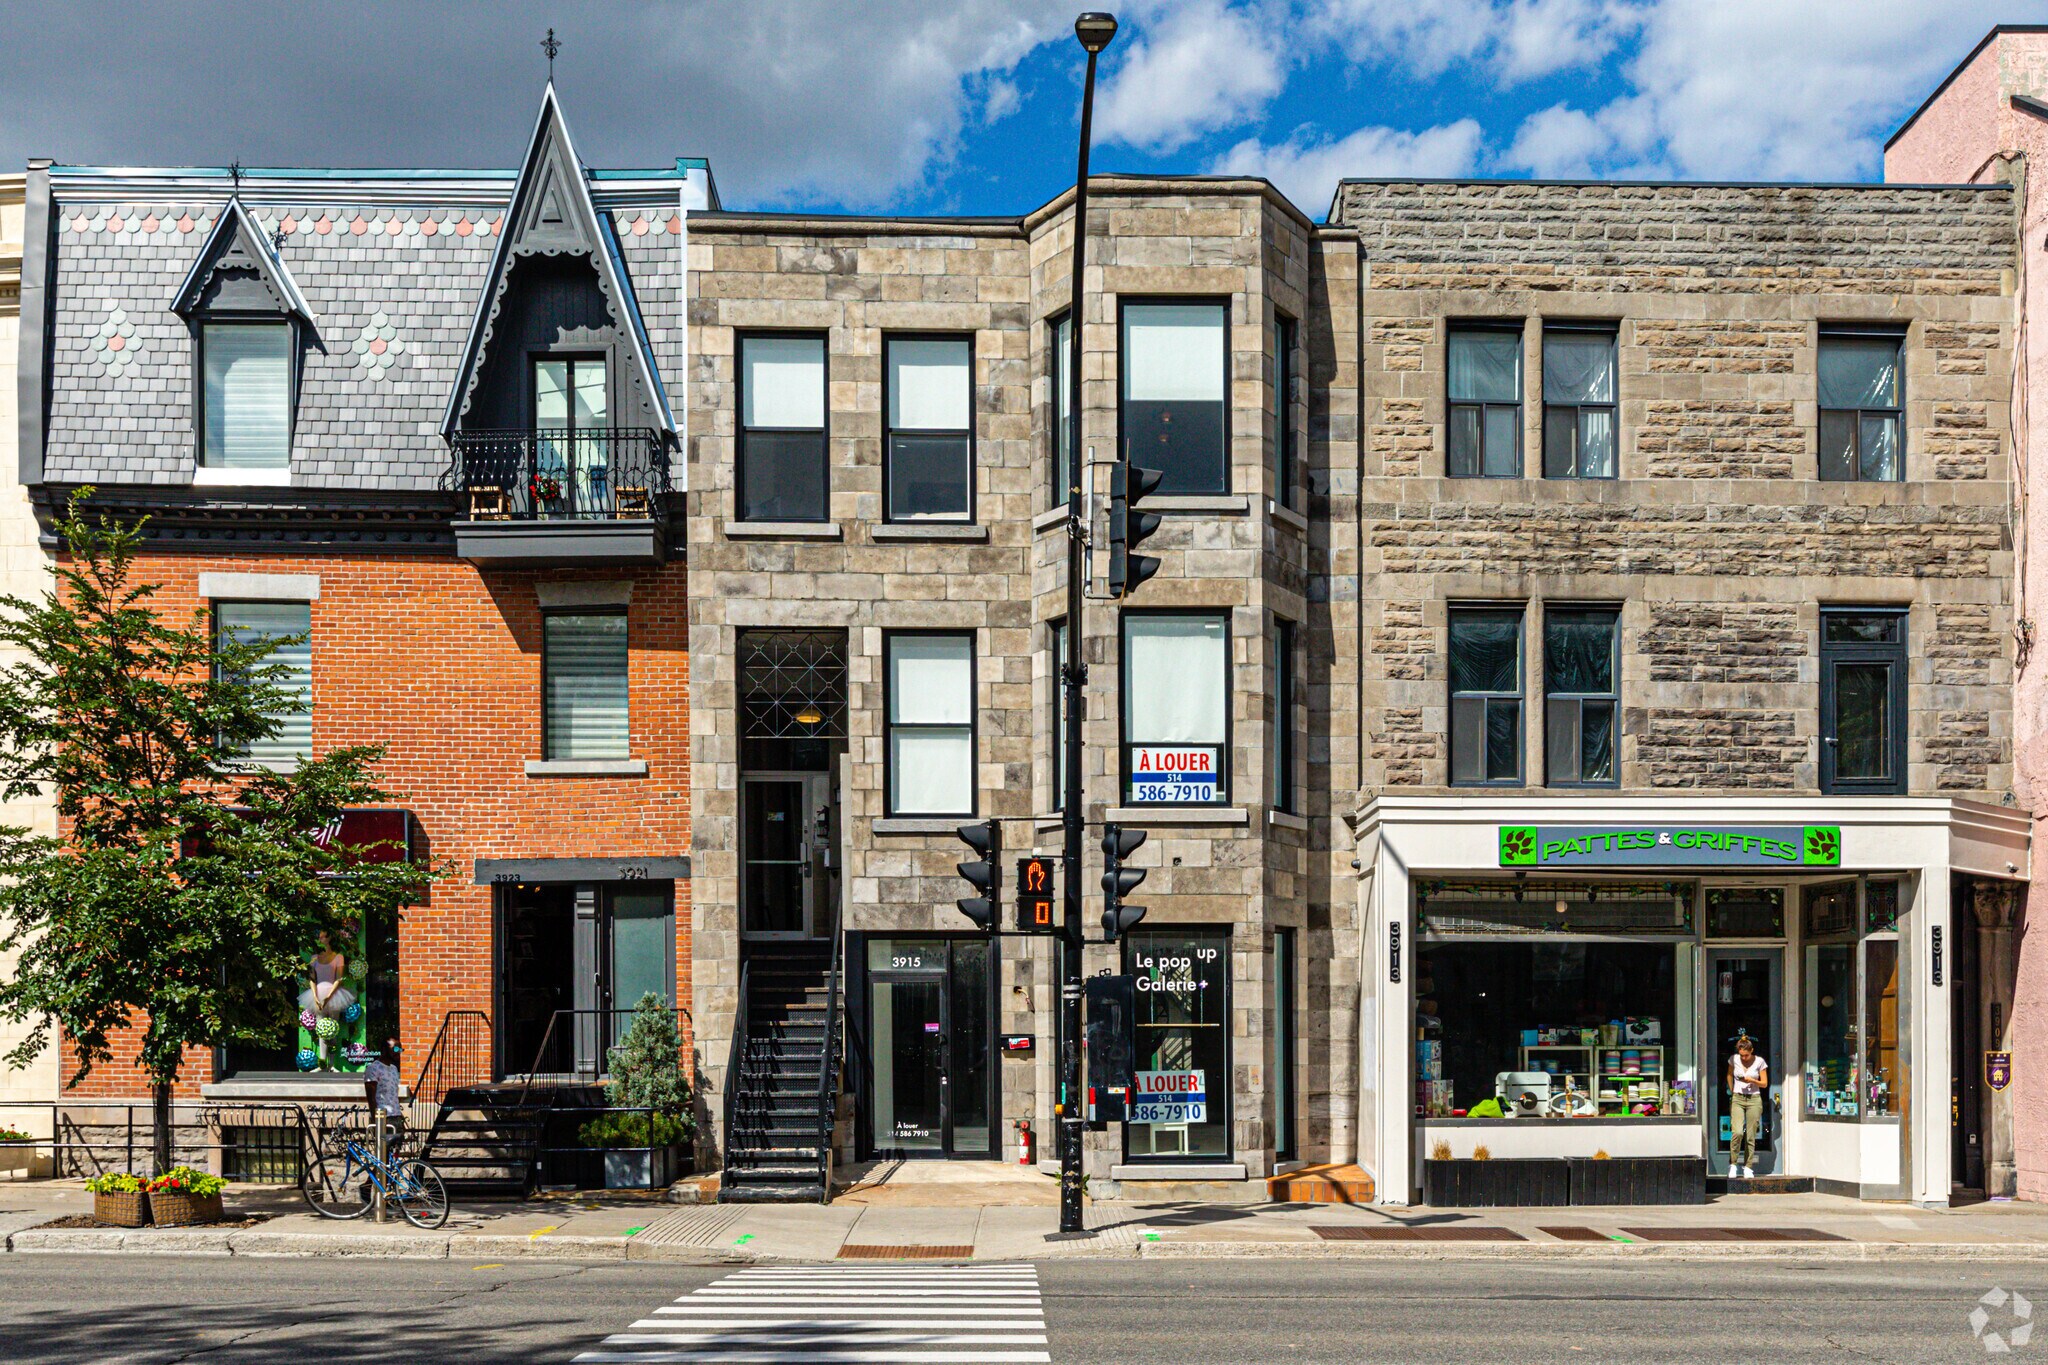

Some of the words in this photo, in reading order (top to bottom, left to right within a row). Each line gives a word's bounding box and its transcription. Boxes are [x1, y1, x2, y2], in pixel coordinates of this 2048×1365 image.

[1139, 749, 1151, 771] À
[1156, 753, 1210, 771] LOUER
[1167, 773, 1182, 783] 514
[1138, 785, 1211, 801] 586-7910
[1543, 831, 1656, 861] PATTES
[1658, 832, 1671, 846] &
[1673, 831, 1798, 861] GRIFFES
[495, 873, 521, 882] 3923
[1035, 902, 1049, 924] 0
[1136, 952, 1153, 968] Le
[1159, 957, 1191, 972] pop
[1196, 948, 1217, 964] up
[1390, 922, 1400, 981] 3913
[1932, 926, 1942, 983] 3913
[892, 957, 921, 967] 3915
[1146, 1075, 1199, 1092] LOUER
[1158, 1094, 1172, 1102] 514
[1131, 1104, 1201, 1120] 586-7910
